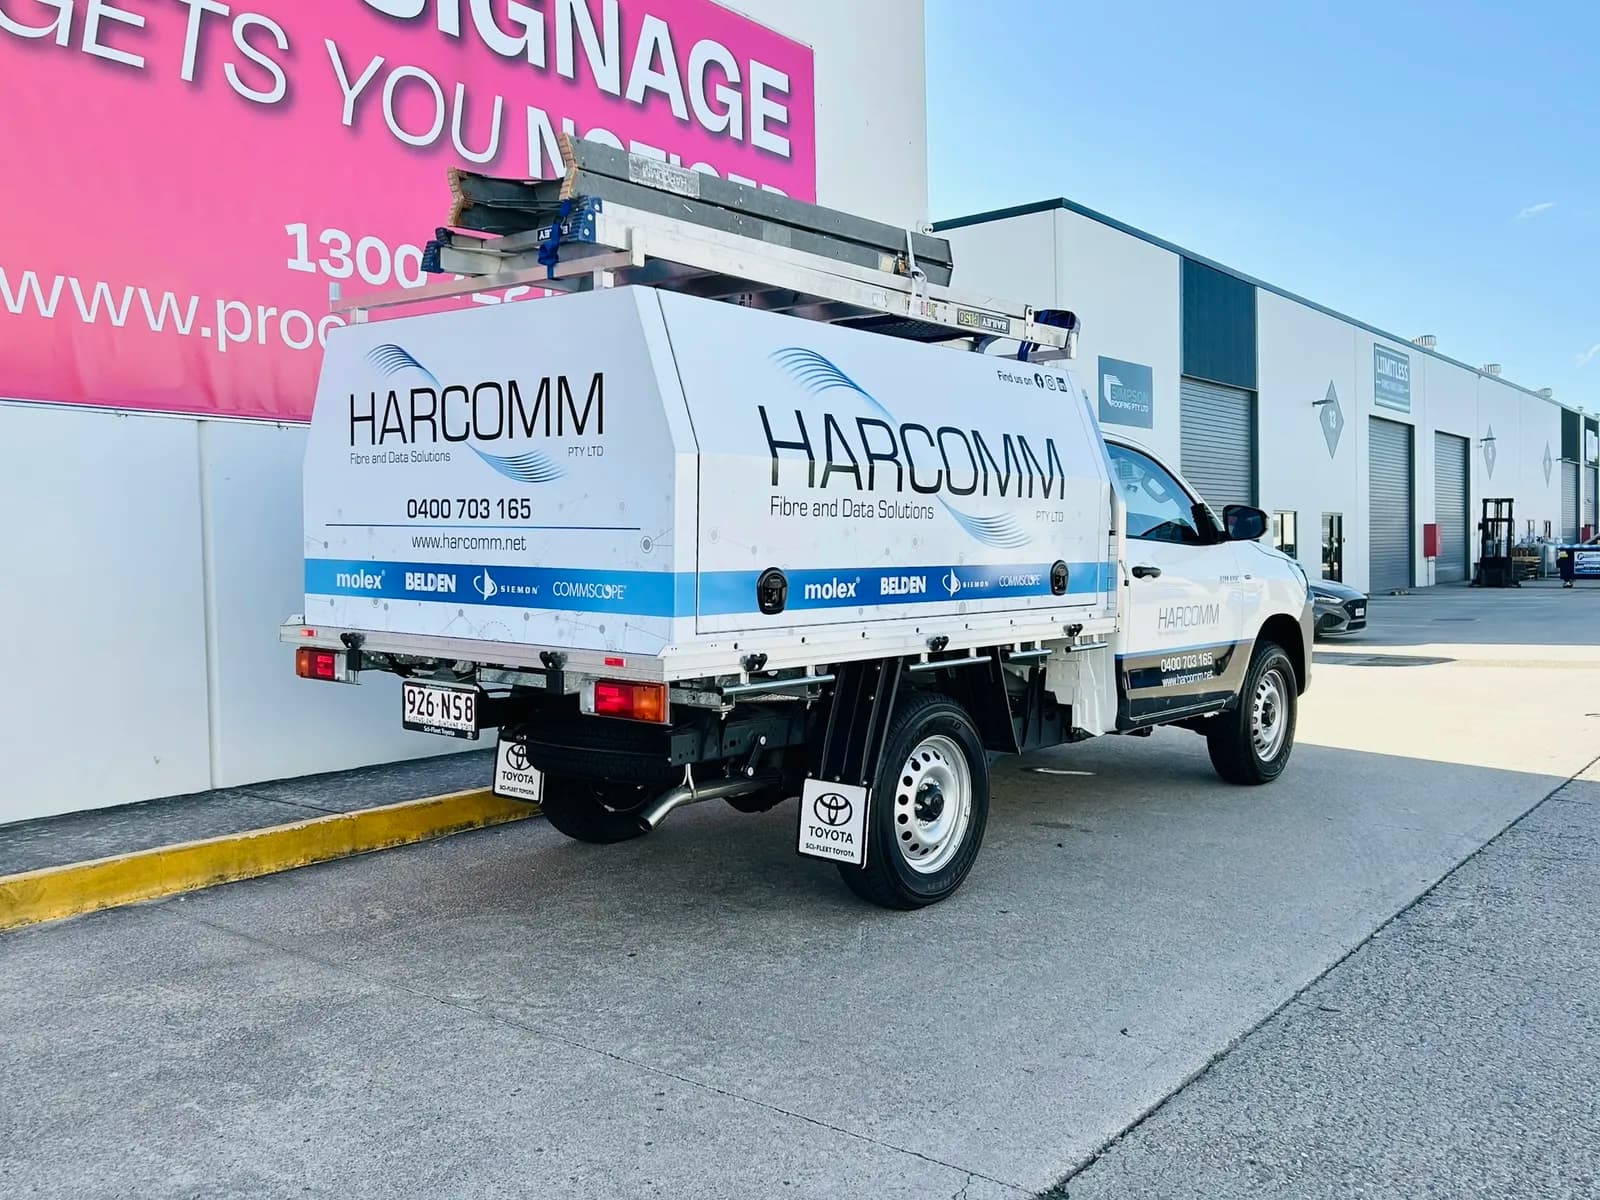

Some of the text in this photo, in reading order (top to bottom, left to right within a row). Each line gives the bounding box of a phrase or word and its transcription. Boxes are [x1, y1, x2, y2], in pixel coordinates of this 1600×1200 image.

[357, 0, 790, 158] GNAGE
[325, 38, 503, 163] YOU
[284, 222, 428, 290] 1300
[982, 317, 1007, 331] BAILEY
[349, 372, 605, 446] HARCOMM
[1328, 409, 1337, 429] 13
[350, 450, 451, 465] Fibre and Data Solutions
[568, 445, 604, 457] PTY LTD
[757, 405, 1065, 500] HARCOMM
[407, 498, 531, 519] 0400 703 165
[770, 495, 934, 520] Fibre and Data Solutions
[1036, 511, 1064, 522] PTY LTD
[411, 533, 527, 551] www.harcomm.net
[405, 572, 456, 593] BELDEN
[500, 585, 538, 595] SIEMON
[553, 581, 625, 600] COMMSCOPE
[880, 575, 927, 596] BELDEN
[962, 580, 989, 588] SIEMON
[999, 574, 1041, 588] COMMSCOPE
[1158, 603, 1220, 629] HARCOMM
[1160, 652, 1213, 673] 0400 703 165
[501, 770, 535, 785] TOYOTA
[499, 785, 535, 796] SCI-FLEET TOYOTA
[808, 825, 854, 845] TOYOTA
[805, 842, 855, 858] SCI-FLEET TOYOTA
